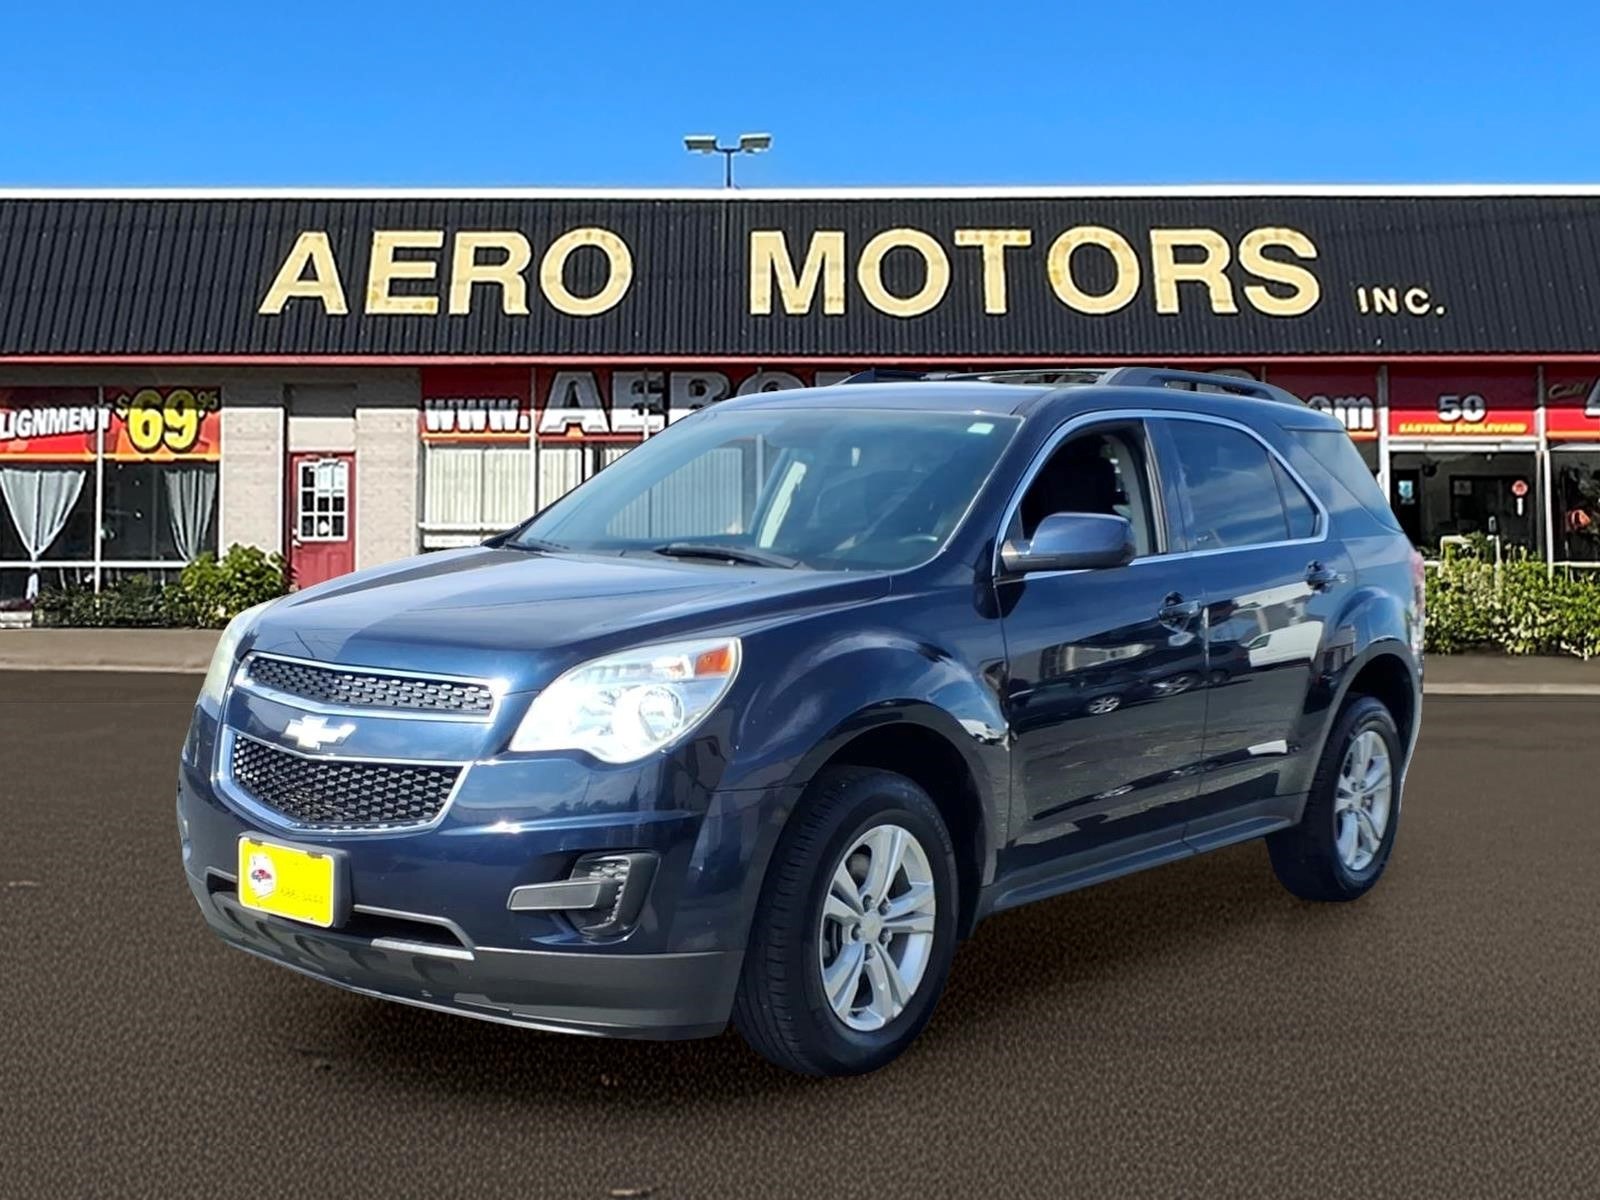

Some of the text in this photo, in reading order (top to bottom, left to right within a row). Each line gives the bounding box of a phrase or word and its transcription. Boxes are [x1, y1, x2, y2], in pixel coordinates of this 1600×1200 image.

[258, 226, 1444, 317] AERO MOTORS INC.
[1438, 394, 1486, 421] 50
